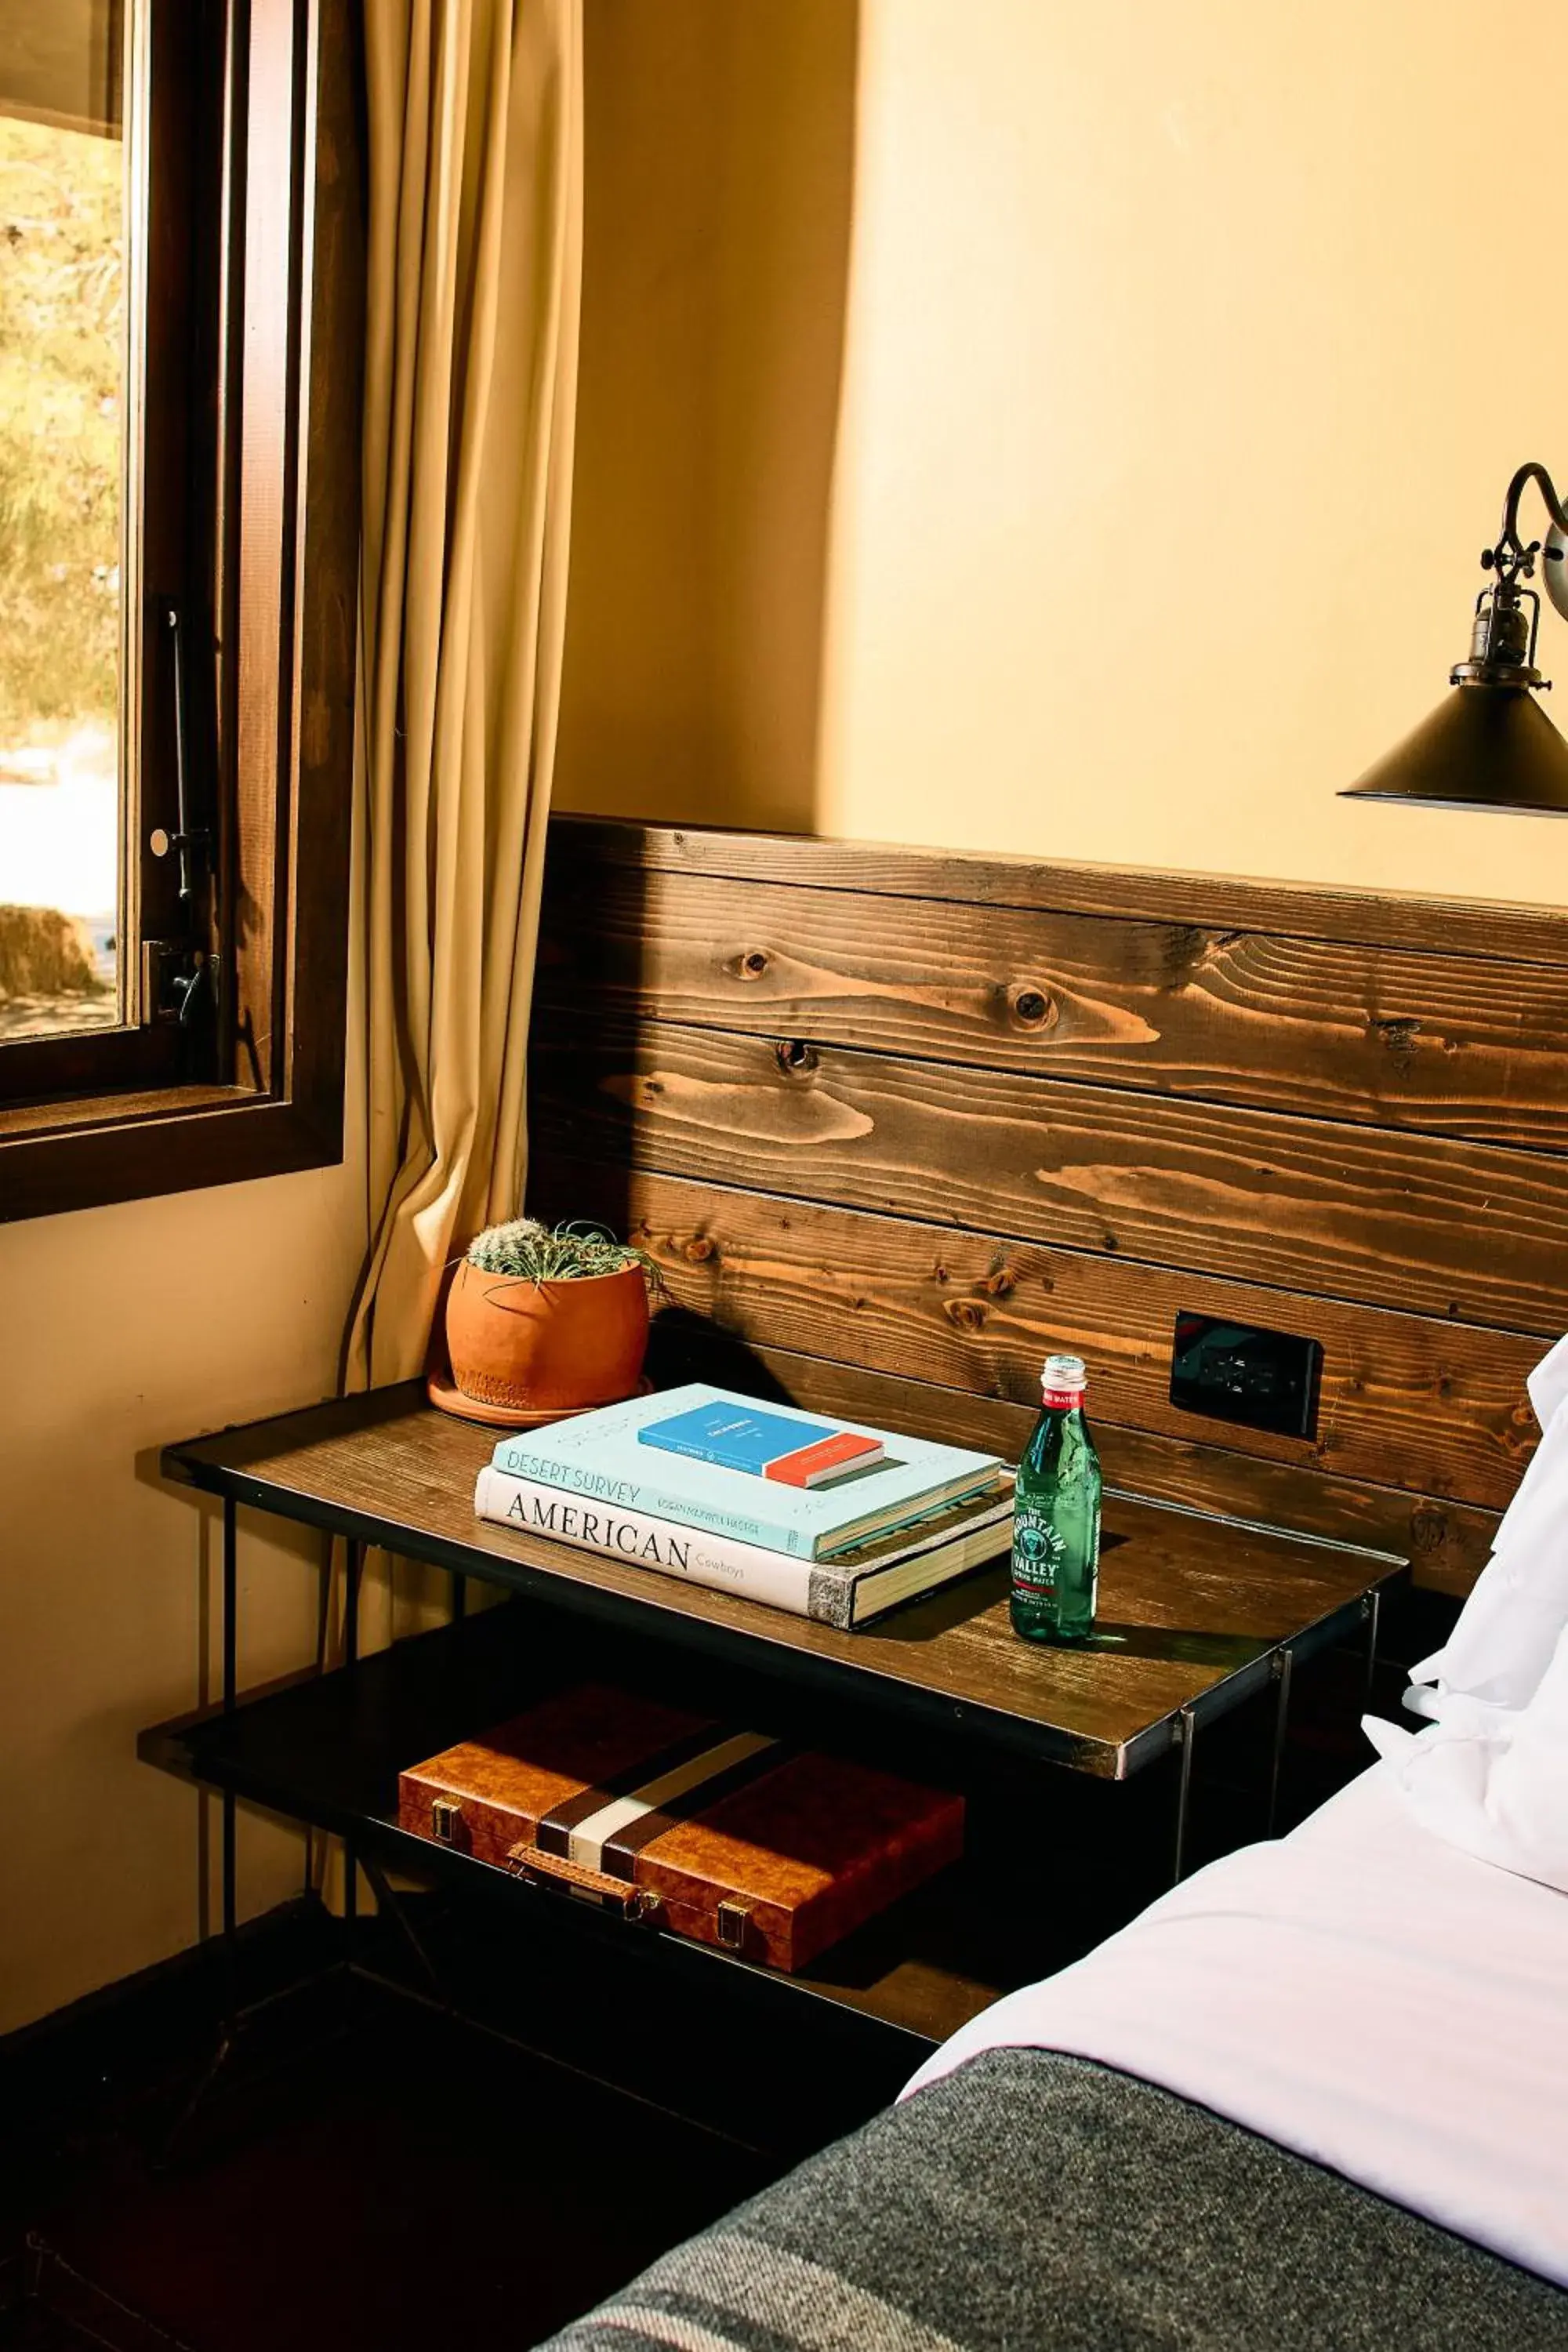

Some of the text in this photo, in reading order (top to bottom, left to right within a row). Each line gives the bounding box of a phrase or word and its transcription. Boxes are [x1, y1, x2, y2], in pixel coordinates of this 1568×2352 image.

[507, 1450, 641, 1503] DESERT SURVEY
[506, 1492, 692, 1571] AMERICAN
[695, 1552, 745, 1579] Cowboys
[1014, 1553, 1056, 1577] VALLEY
